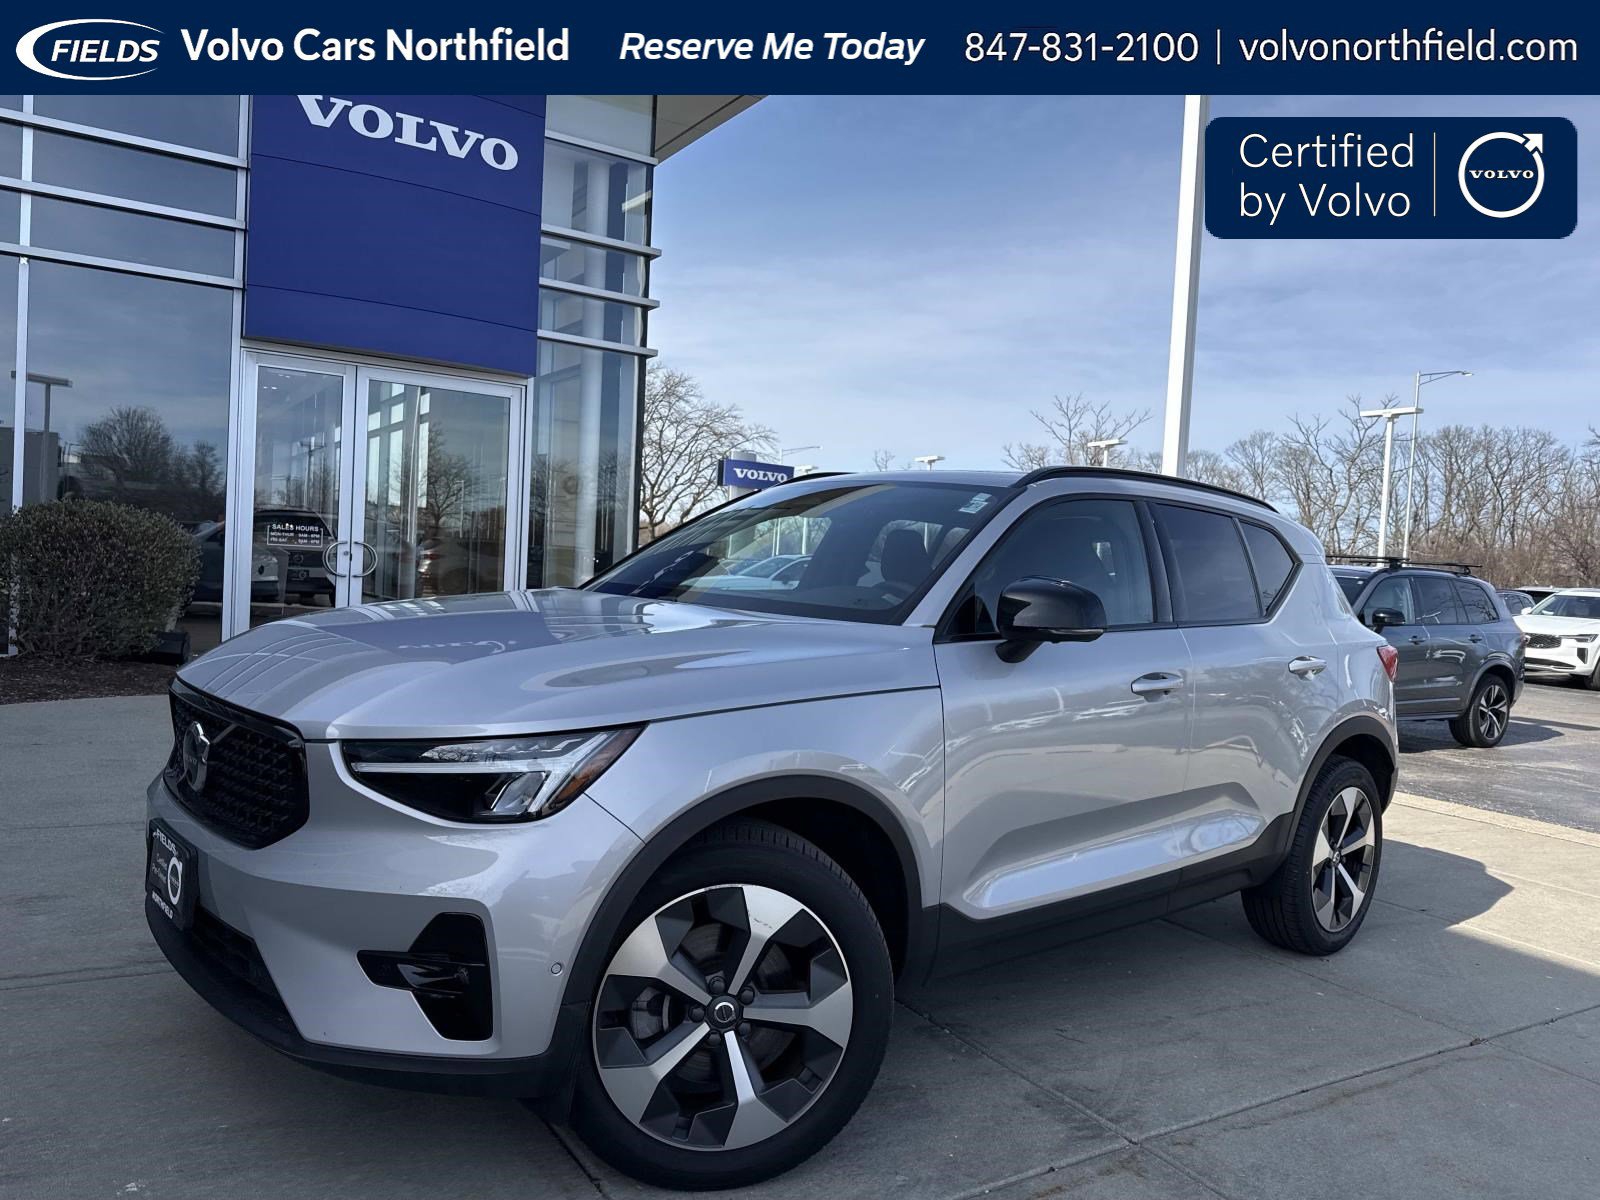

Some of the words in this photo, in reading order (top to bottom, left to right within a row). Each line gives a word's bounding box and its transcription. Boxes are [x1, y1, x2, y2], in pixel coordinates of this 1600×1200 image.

[297, 94, 519, 171] VOLVO
[734, 468, 788, 482] VOLVO
[272, 523, 294, 531] SALES
